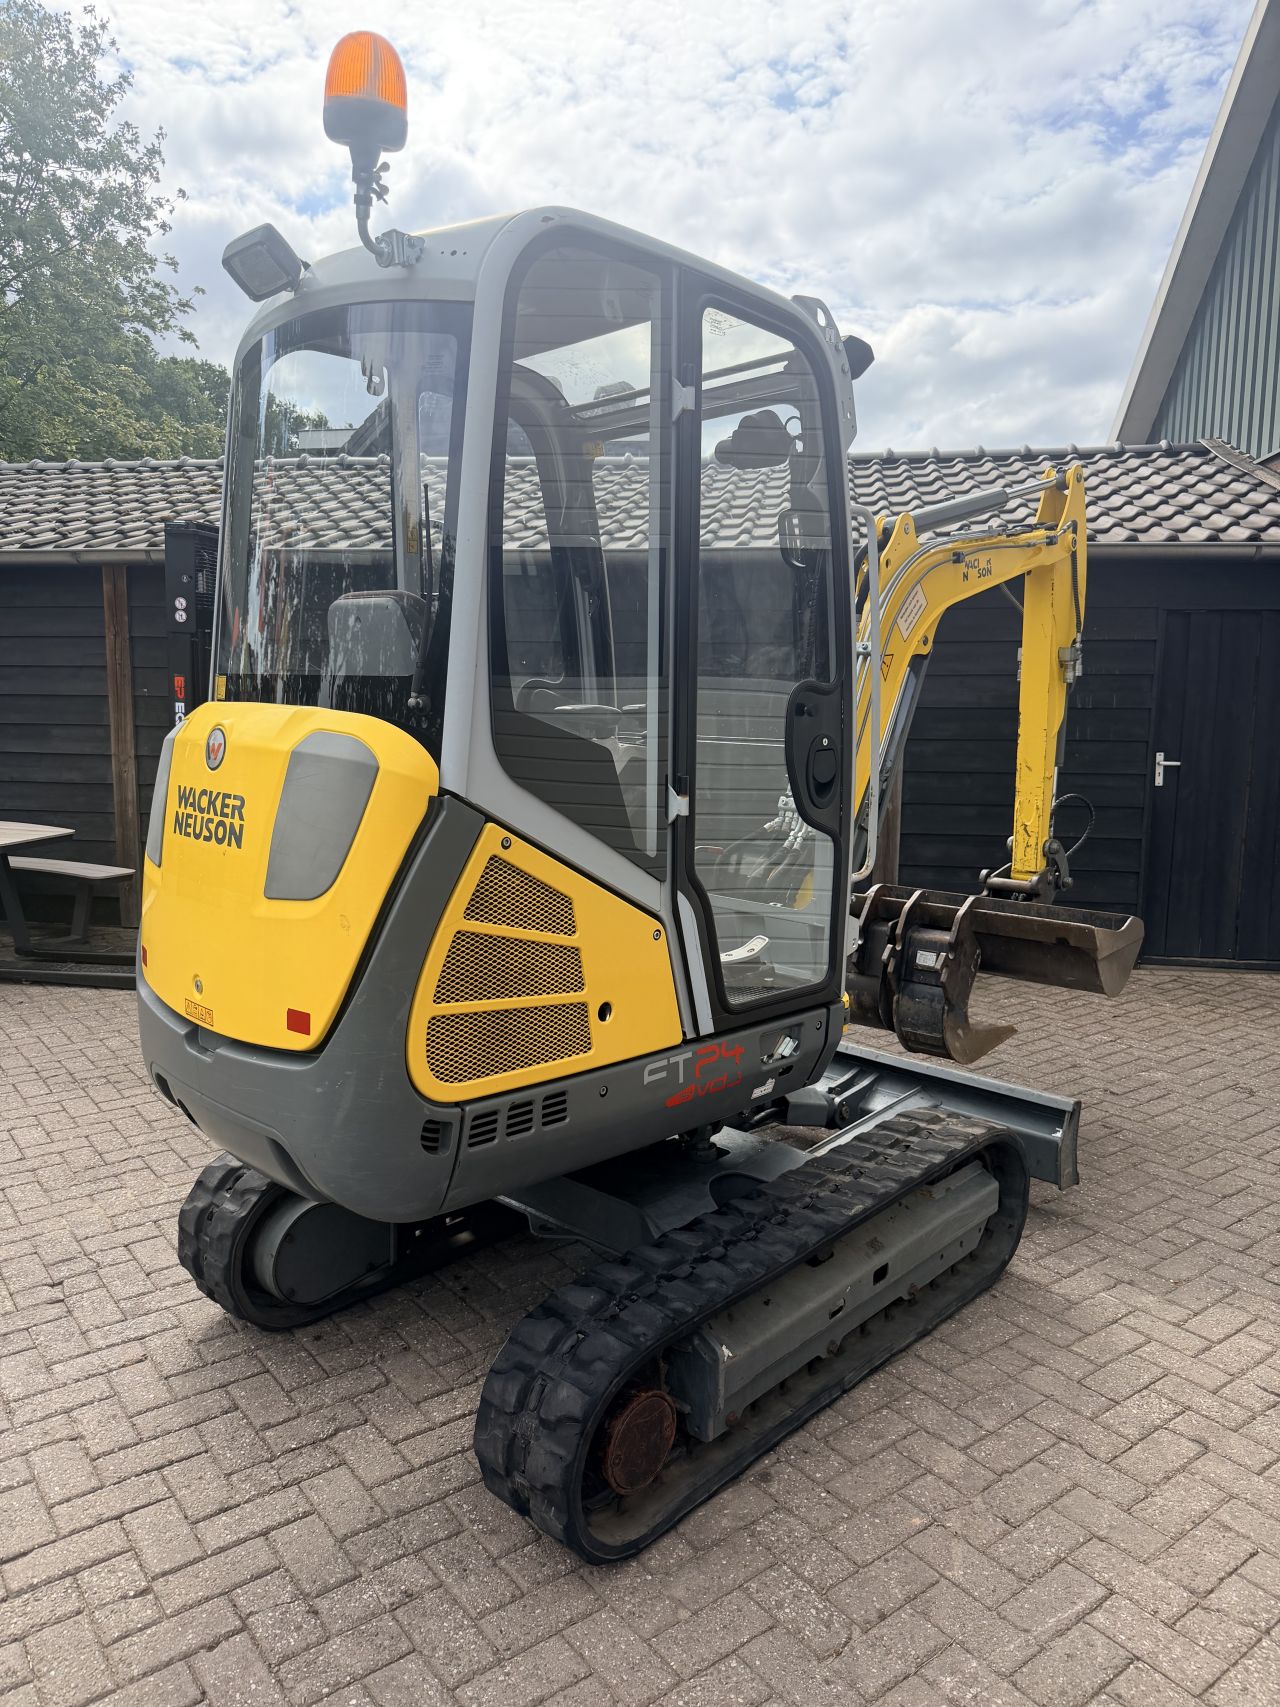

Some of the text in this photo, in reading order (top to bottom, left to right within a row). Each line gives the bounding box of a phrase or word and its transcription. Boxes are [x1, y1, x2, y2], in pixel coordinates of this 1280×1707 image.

[962, 565, 992, 582] NSON
[174, 676, 185, 699] EP
[177, 785, 246, 822] WACKER
[173, 811, 244, 850] NEUSON
